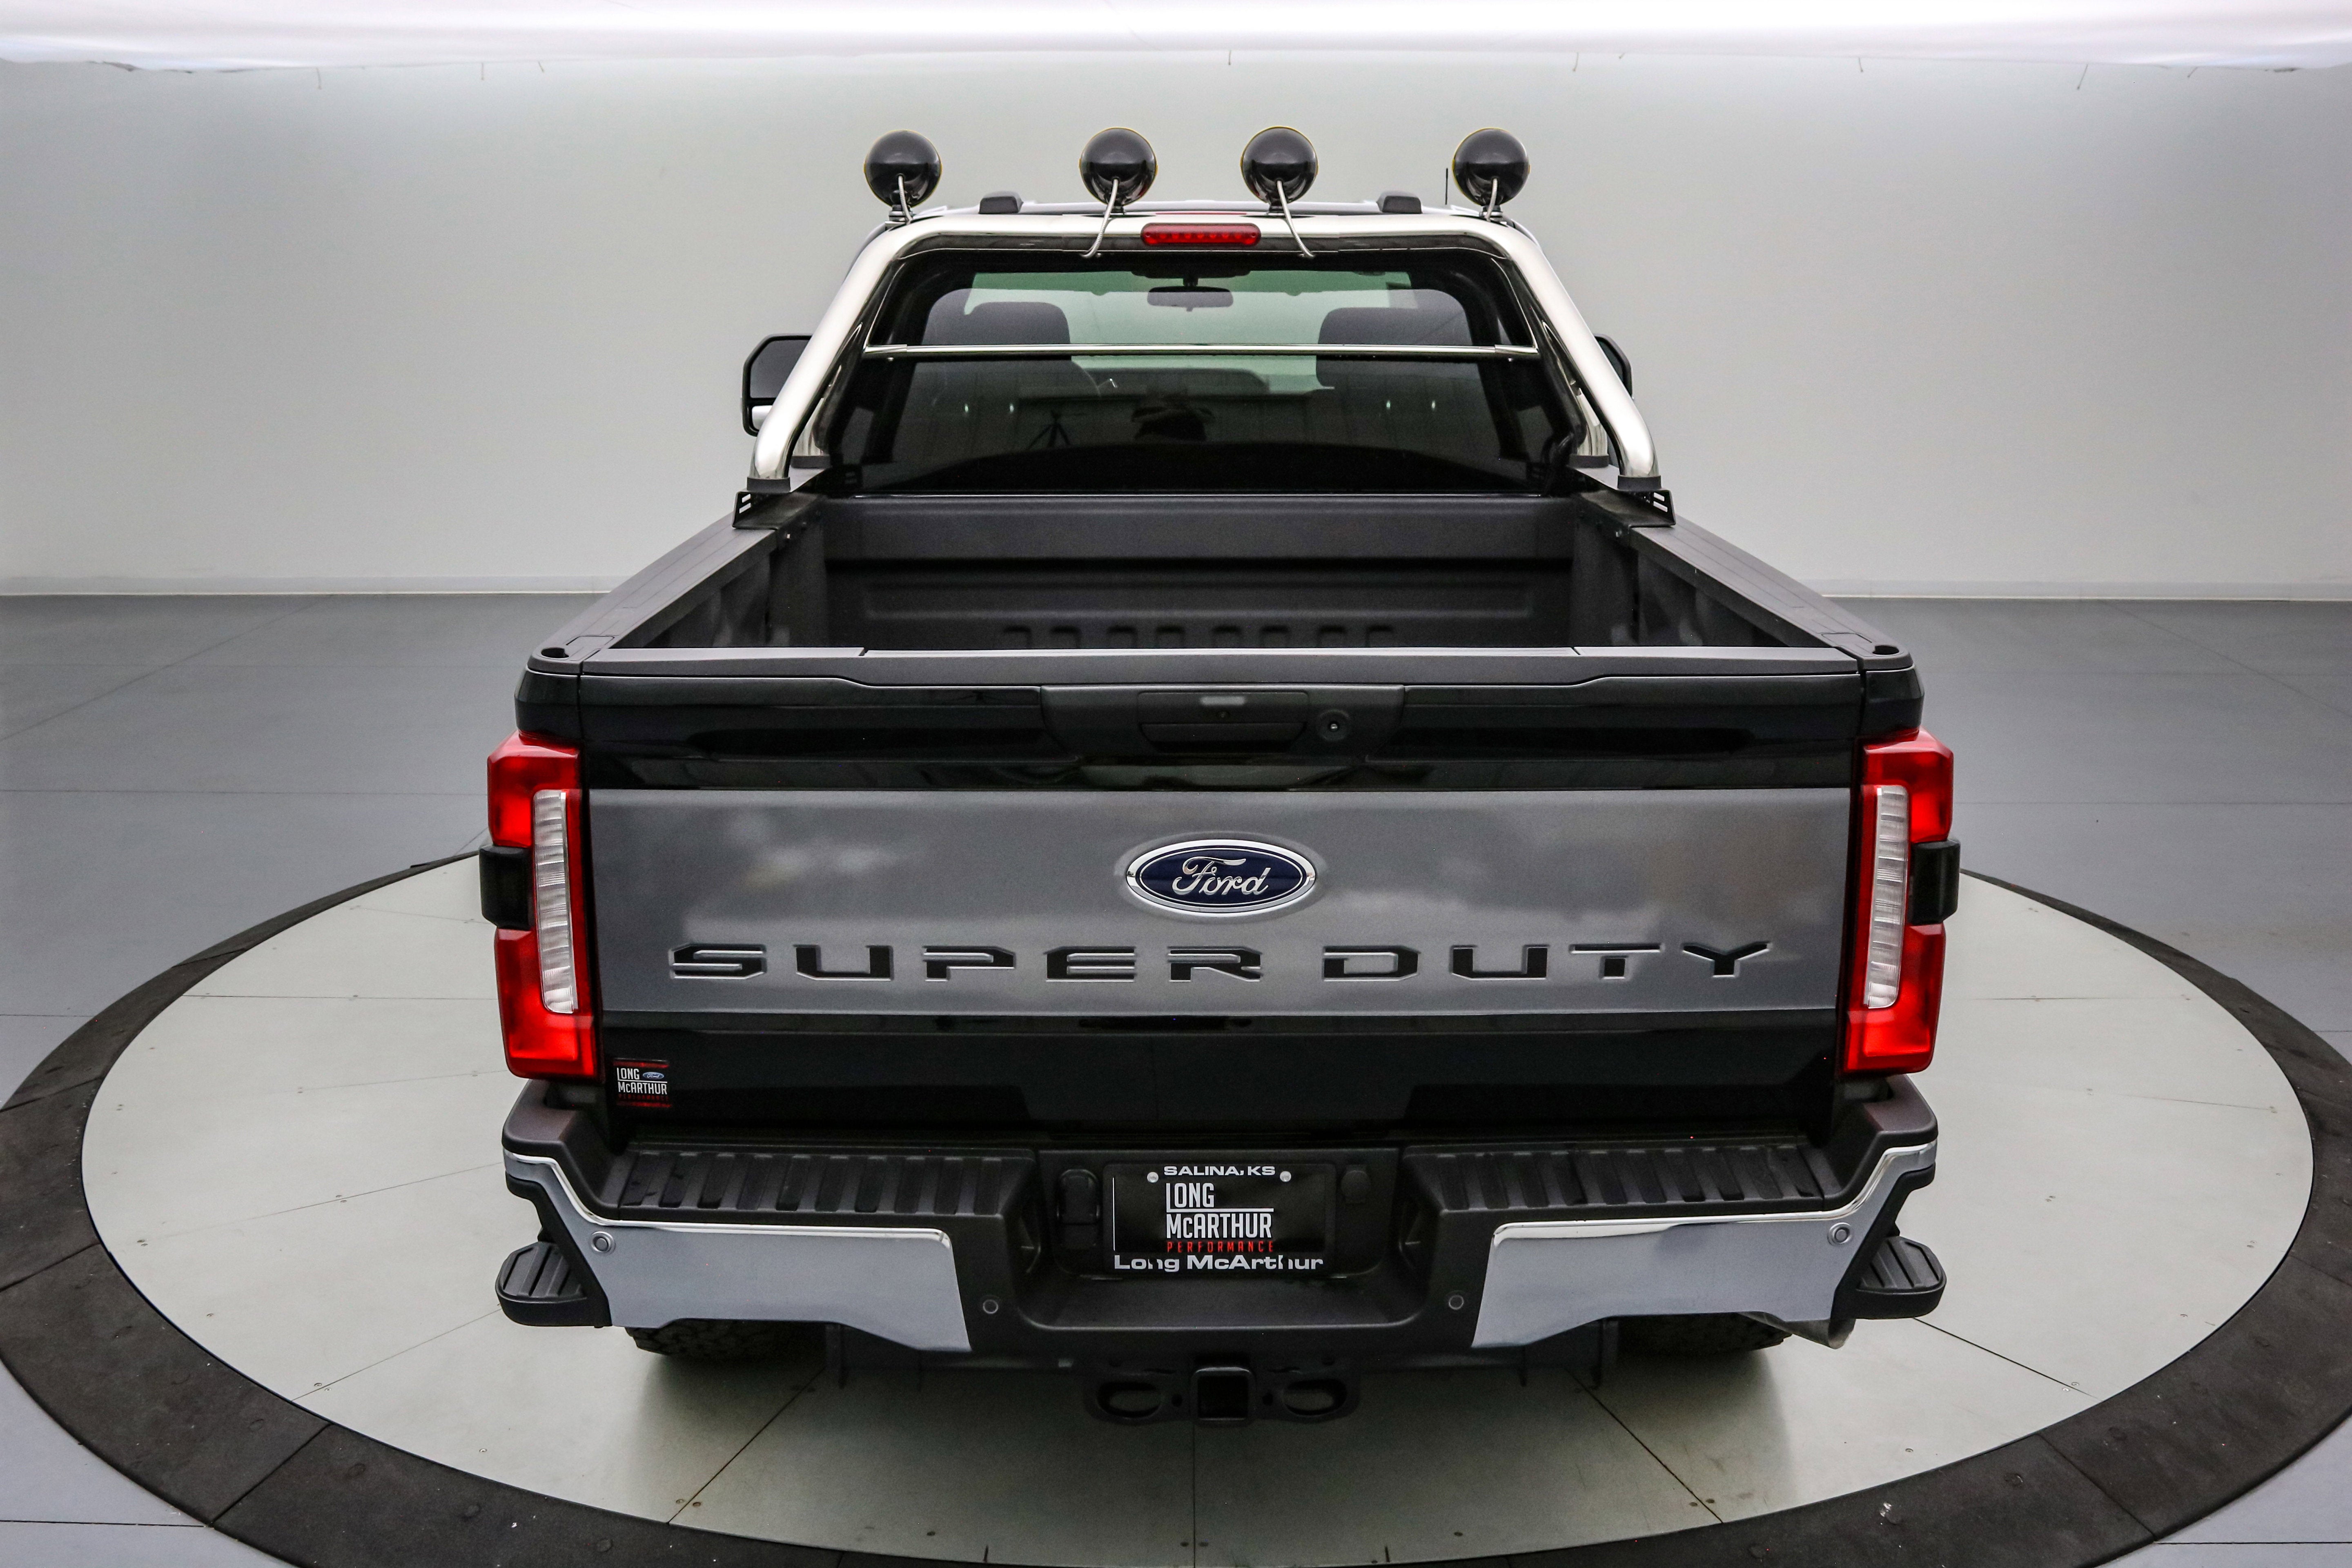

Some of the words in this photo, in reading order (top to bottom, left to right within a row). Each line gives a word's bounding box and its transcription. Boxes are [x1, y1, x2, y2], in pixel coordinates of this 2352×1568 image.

[1172, 856, 1272, 895] Ford
[670, 943, 1262, 981] SUPER
[1323, 943, 1773, 981] DUTY
[617, 1067, 640, 1081] LONG
[618, 1081, 668, 1095] McARTHUR
[1164, 1166, 1244, 1176] SALINA,
[1247, 1166, 1275, 1176] KS
[1166, 1182, 1214, 1212] LONG
[1166, 1213, 1272, 1238] McARTHUR
[1167, 1241, 1274, 1252] PERFORMANCE
